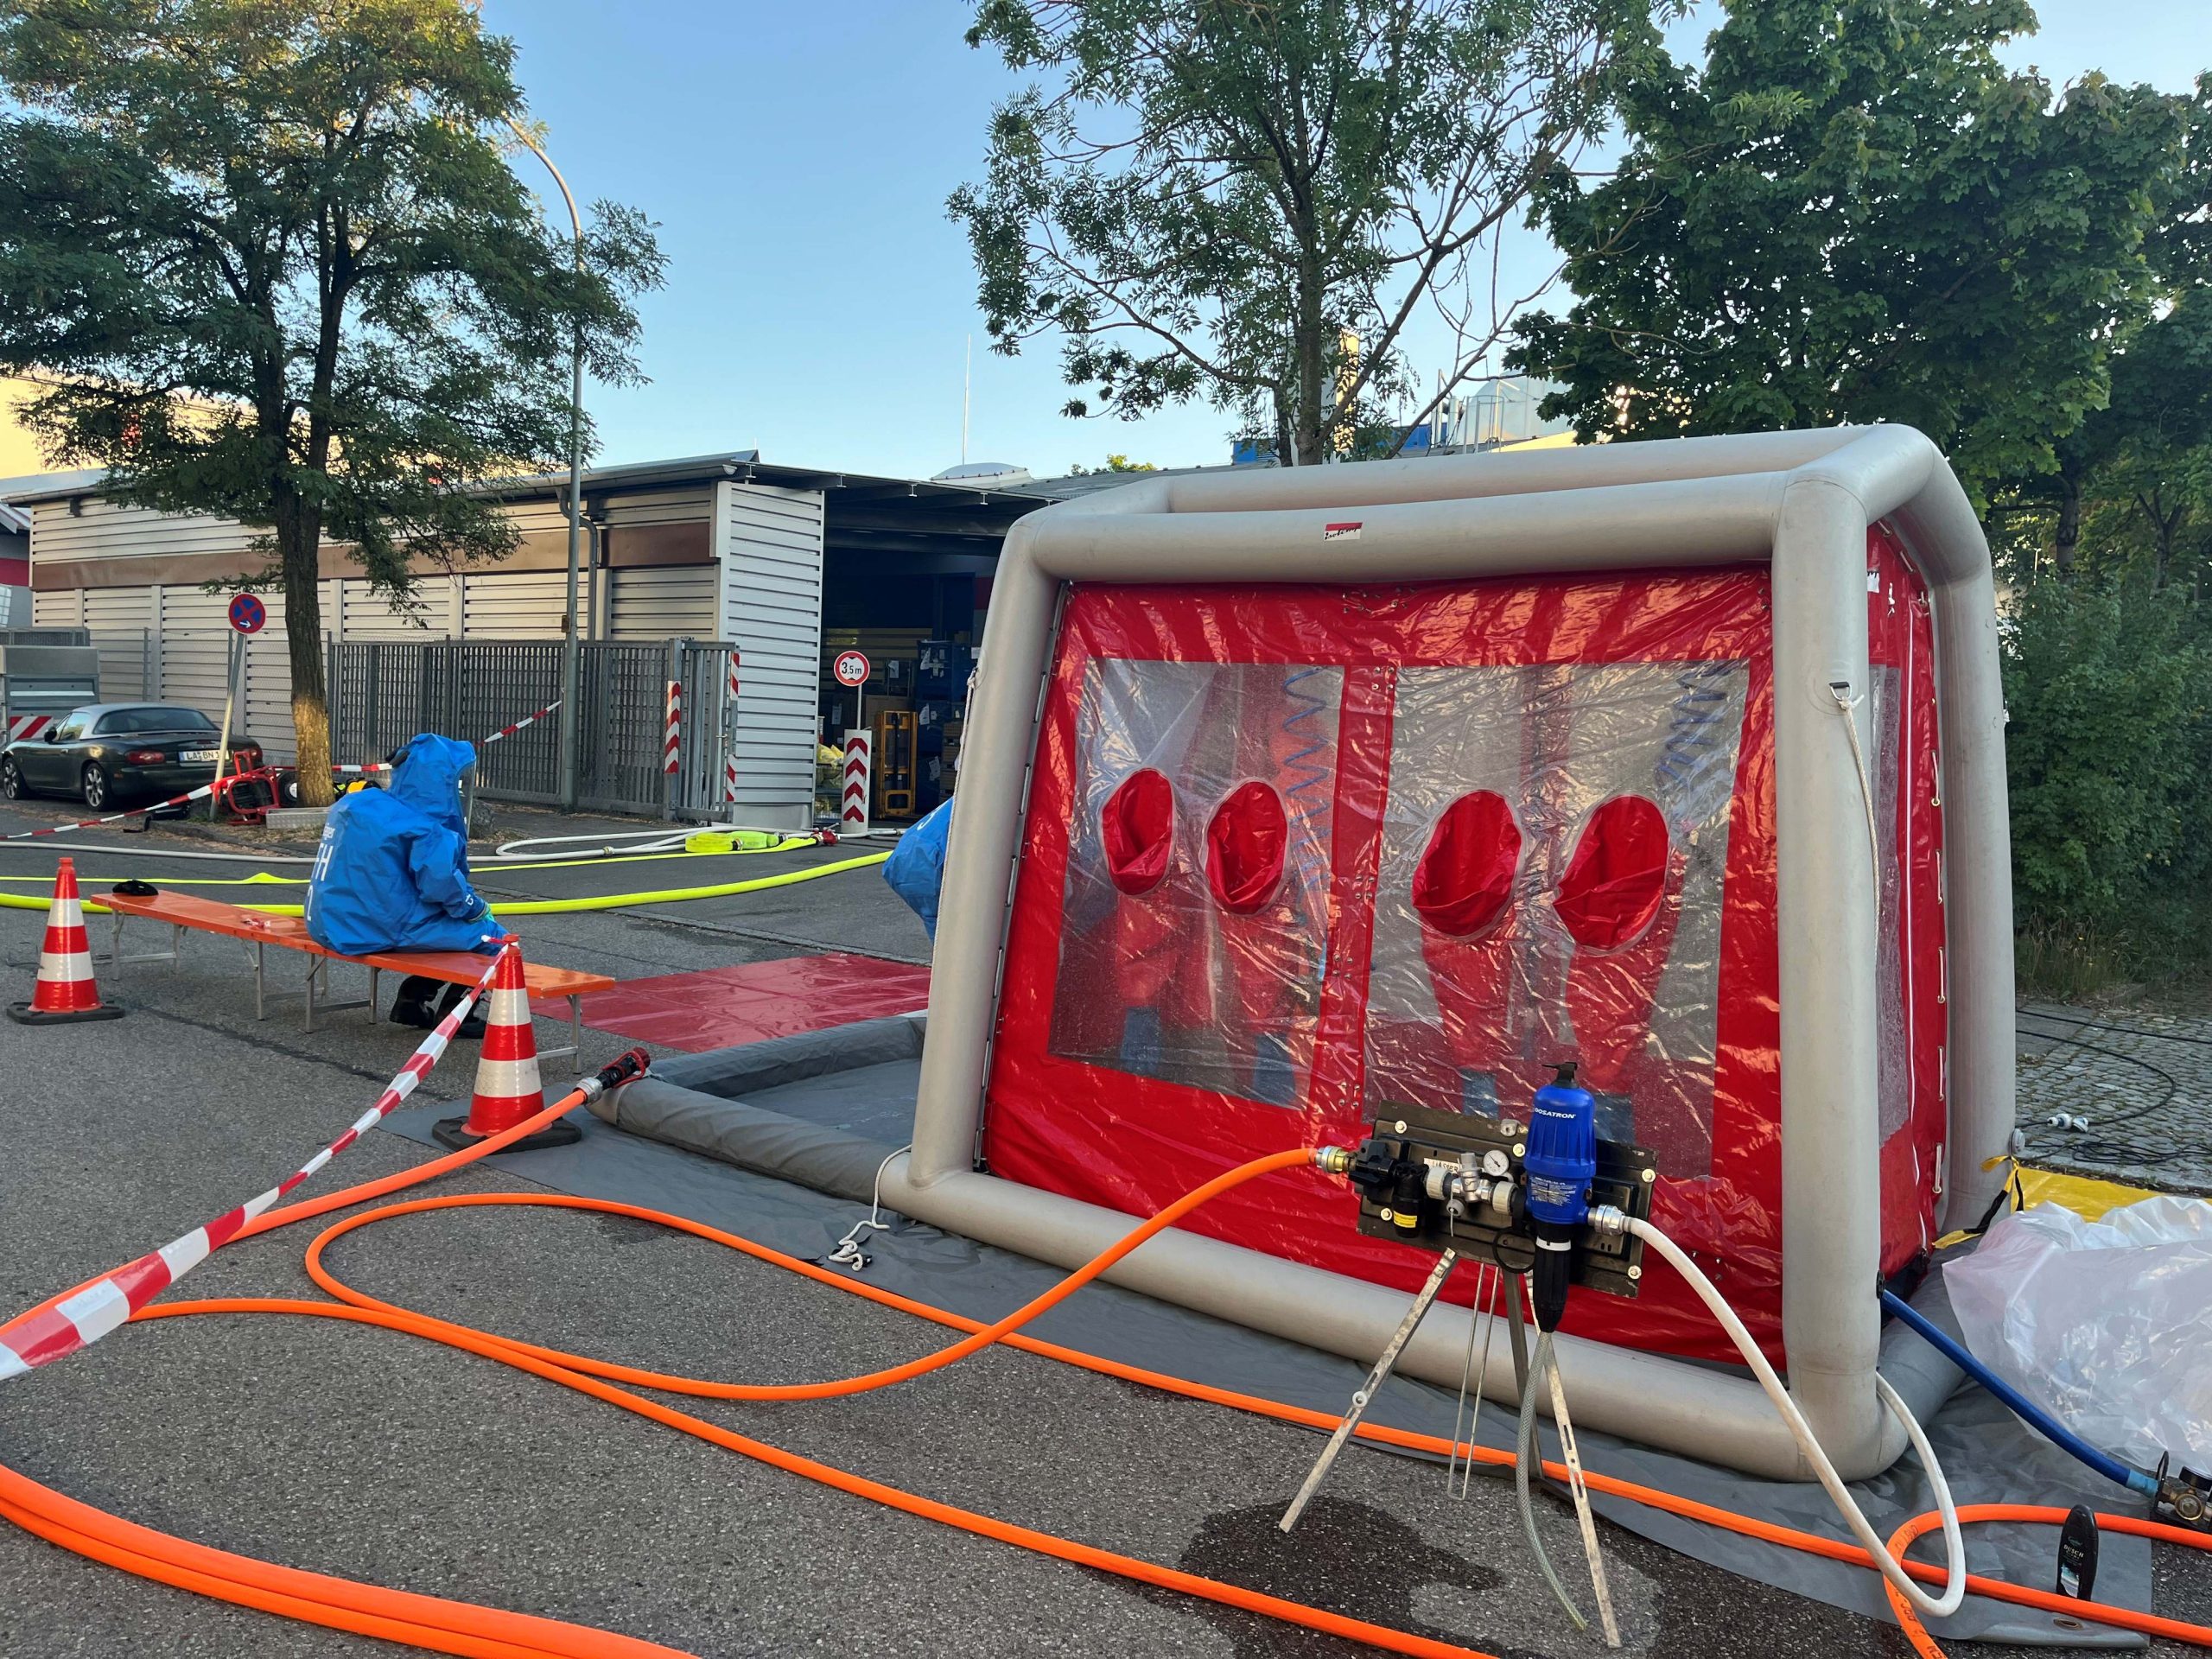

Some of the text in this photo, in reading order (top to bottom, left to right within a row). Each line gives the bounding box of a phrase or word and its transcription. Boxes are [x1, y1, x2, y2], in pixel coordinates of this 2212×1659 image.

[842, 662, 854, 675] 3,5
[202, 751, 214, 760] BN
[1535, 1107, 1577, 1119] DOSATRON
[2063, 1544, 2084, 1558] DUSCH
